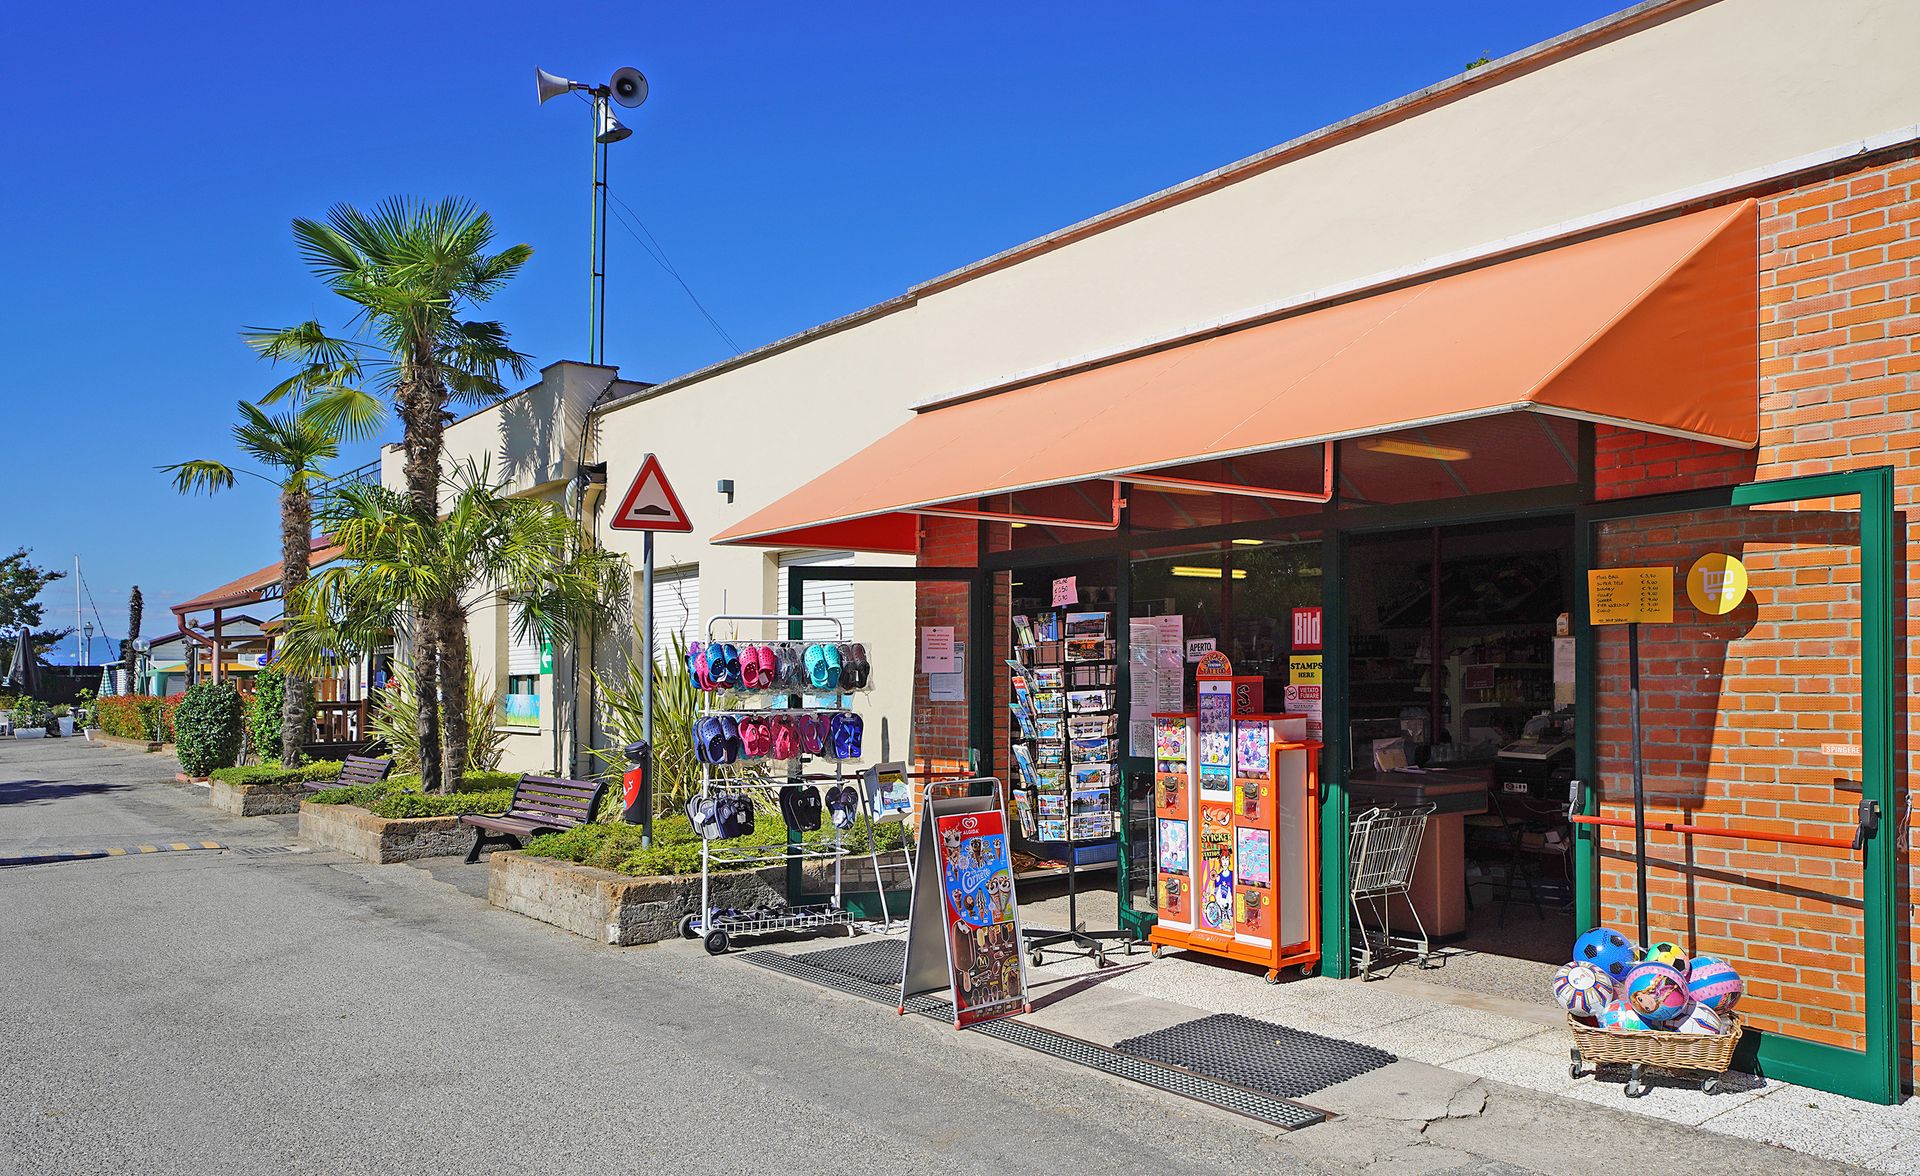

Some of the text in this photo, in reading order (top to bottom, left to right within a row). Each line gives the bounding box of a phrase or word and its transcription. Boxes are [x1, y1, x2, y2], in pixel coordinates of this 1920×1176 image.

[1294, 611, 1321, 645] Bild
[1290, 662, 1323, 670] STAMPS
[1826, 745, 1860, 754] SPINGERE
[1201, 833, 1232, 842] STICKER
